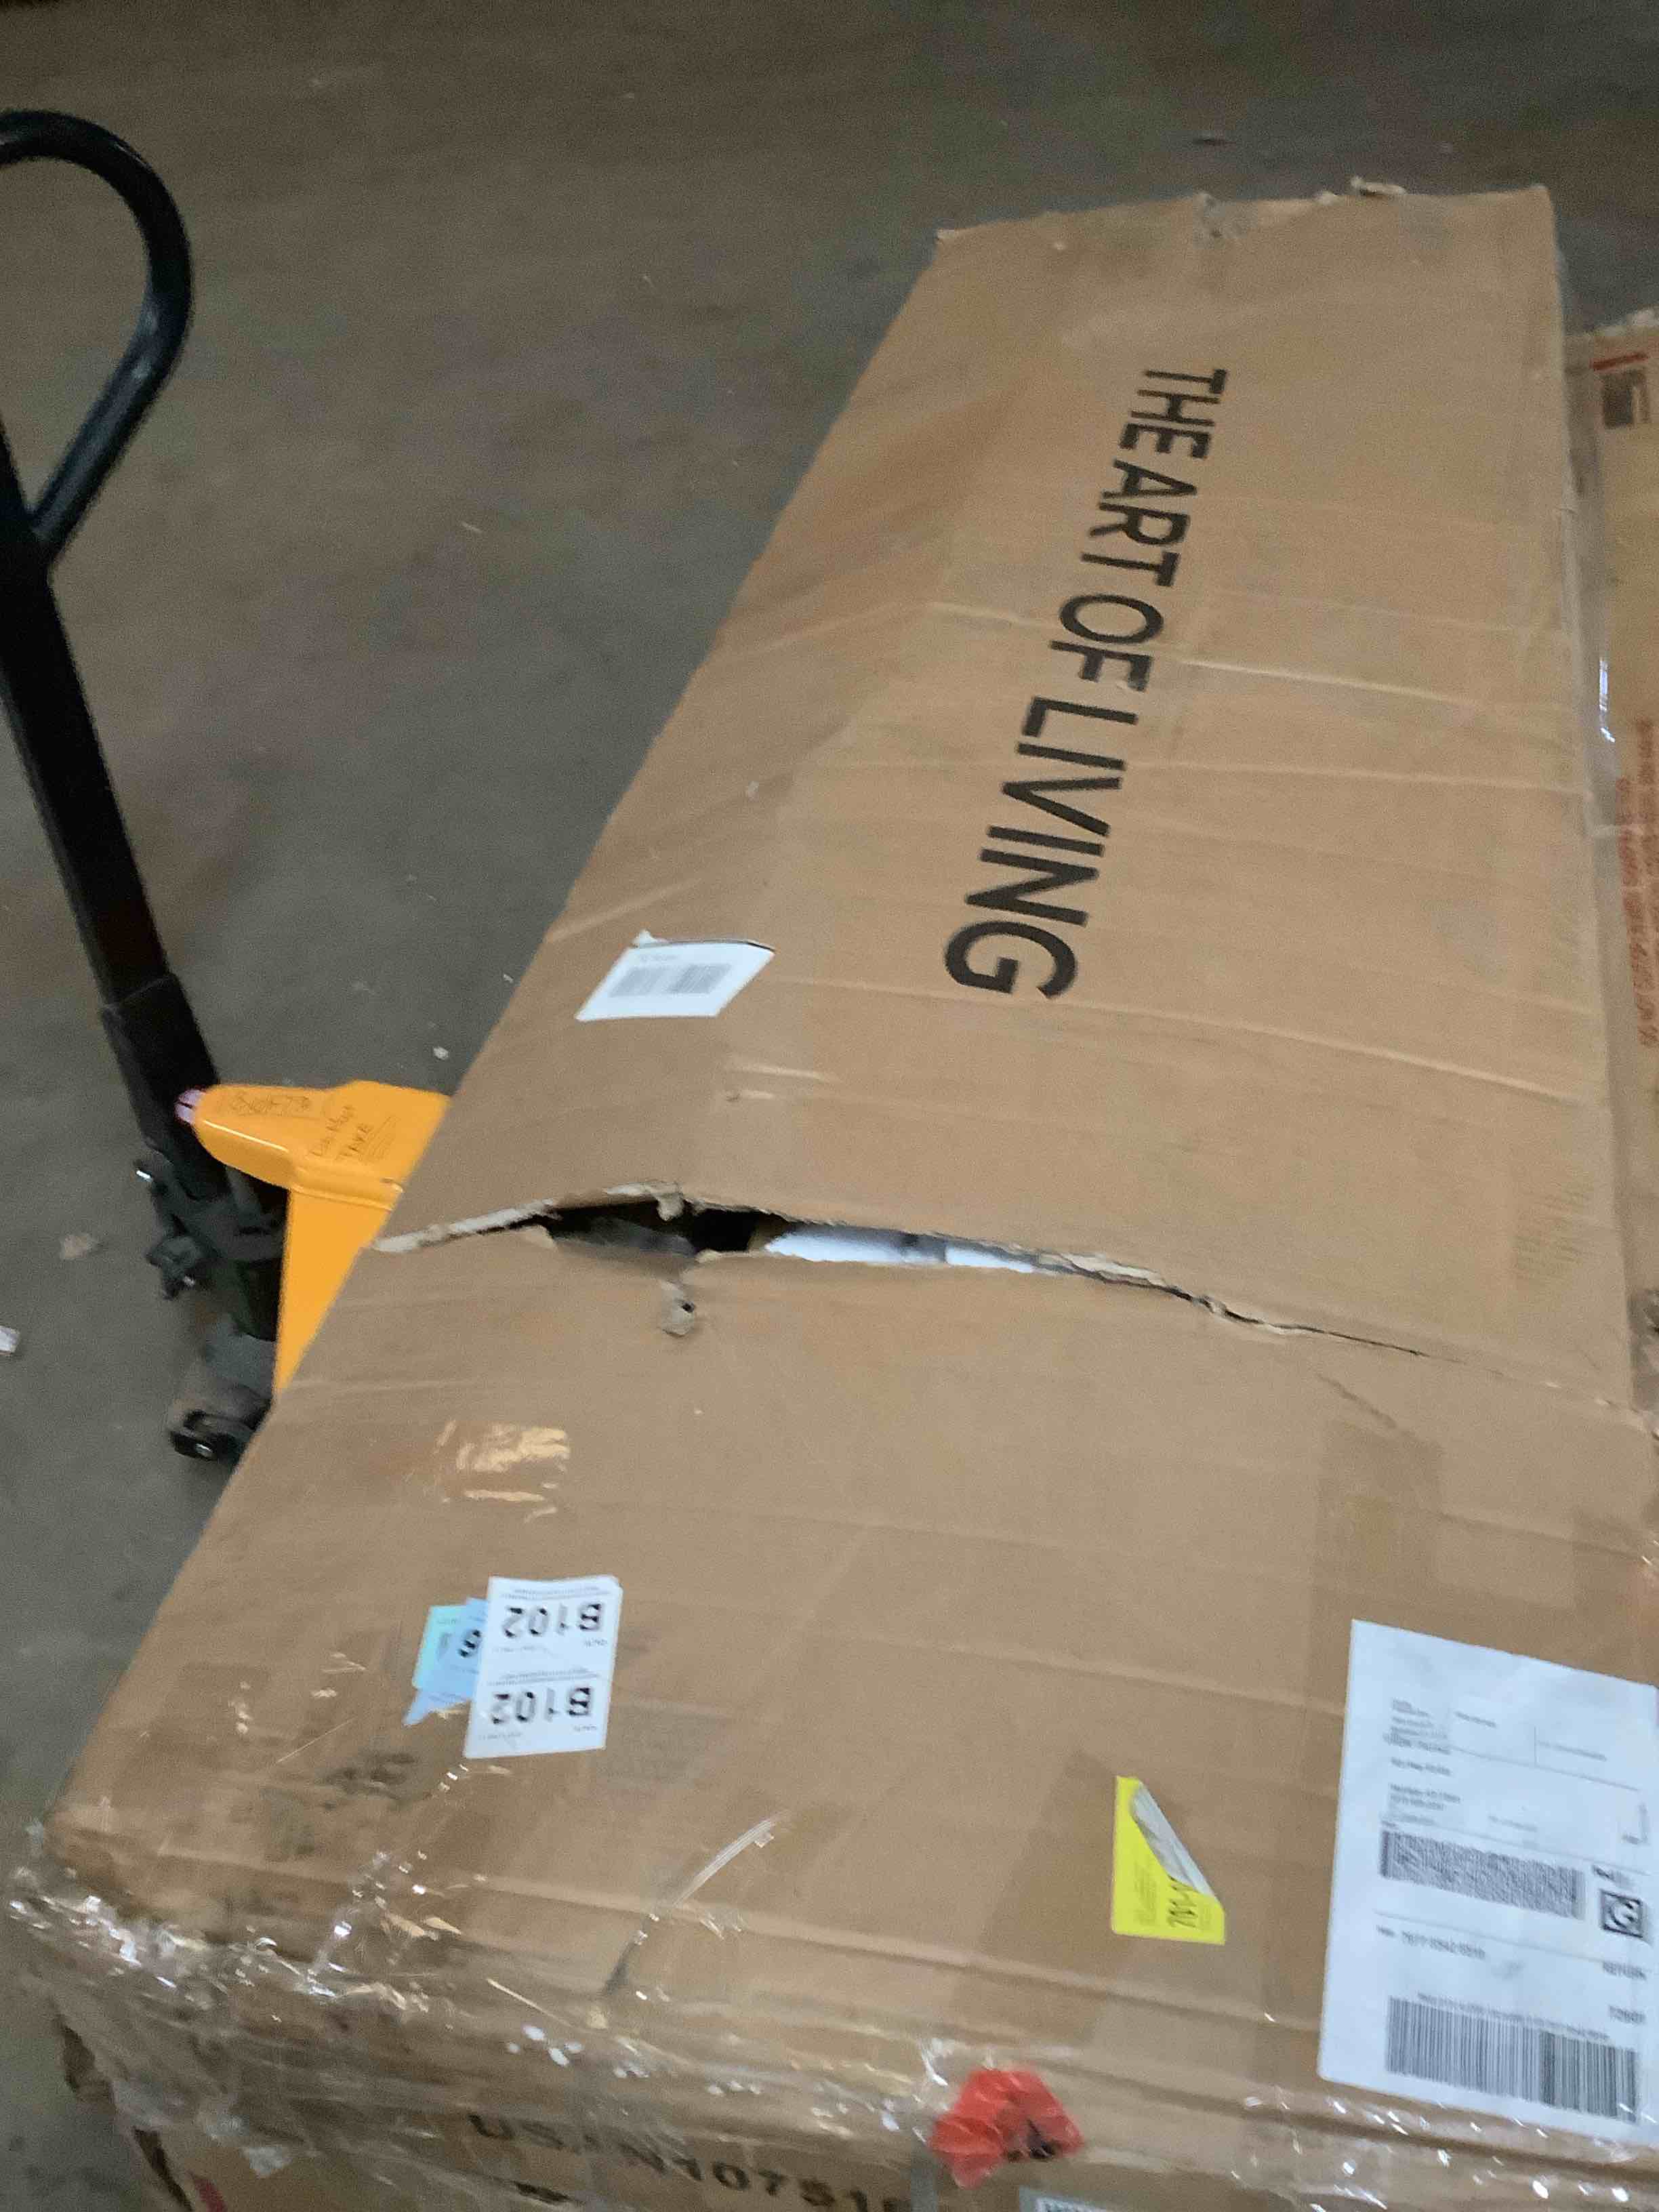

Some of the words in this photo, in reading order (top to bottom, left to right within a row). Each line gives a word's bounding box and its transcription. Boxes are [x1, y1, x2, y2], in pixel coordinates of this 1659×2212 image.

[1118, 369, 1228, 459] THE
[1080, 459, 1198, 588] ART
[1048, 592, 1166, 693] OF
[944, 696, 1140, 1000] LIVING
[502, 1601, 603, 1638] B102
[491, 1685, 593, 1725] B102
